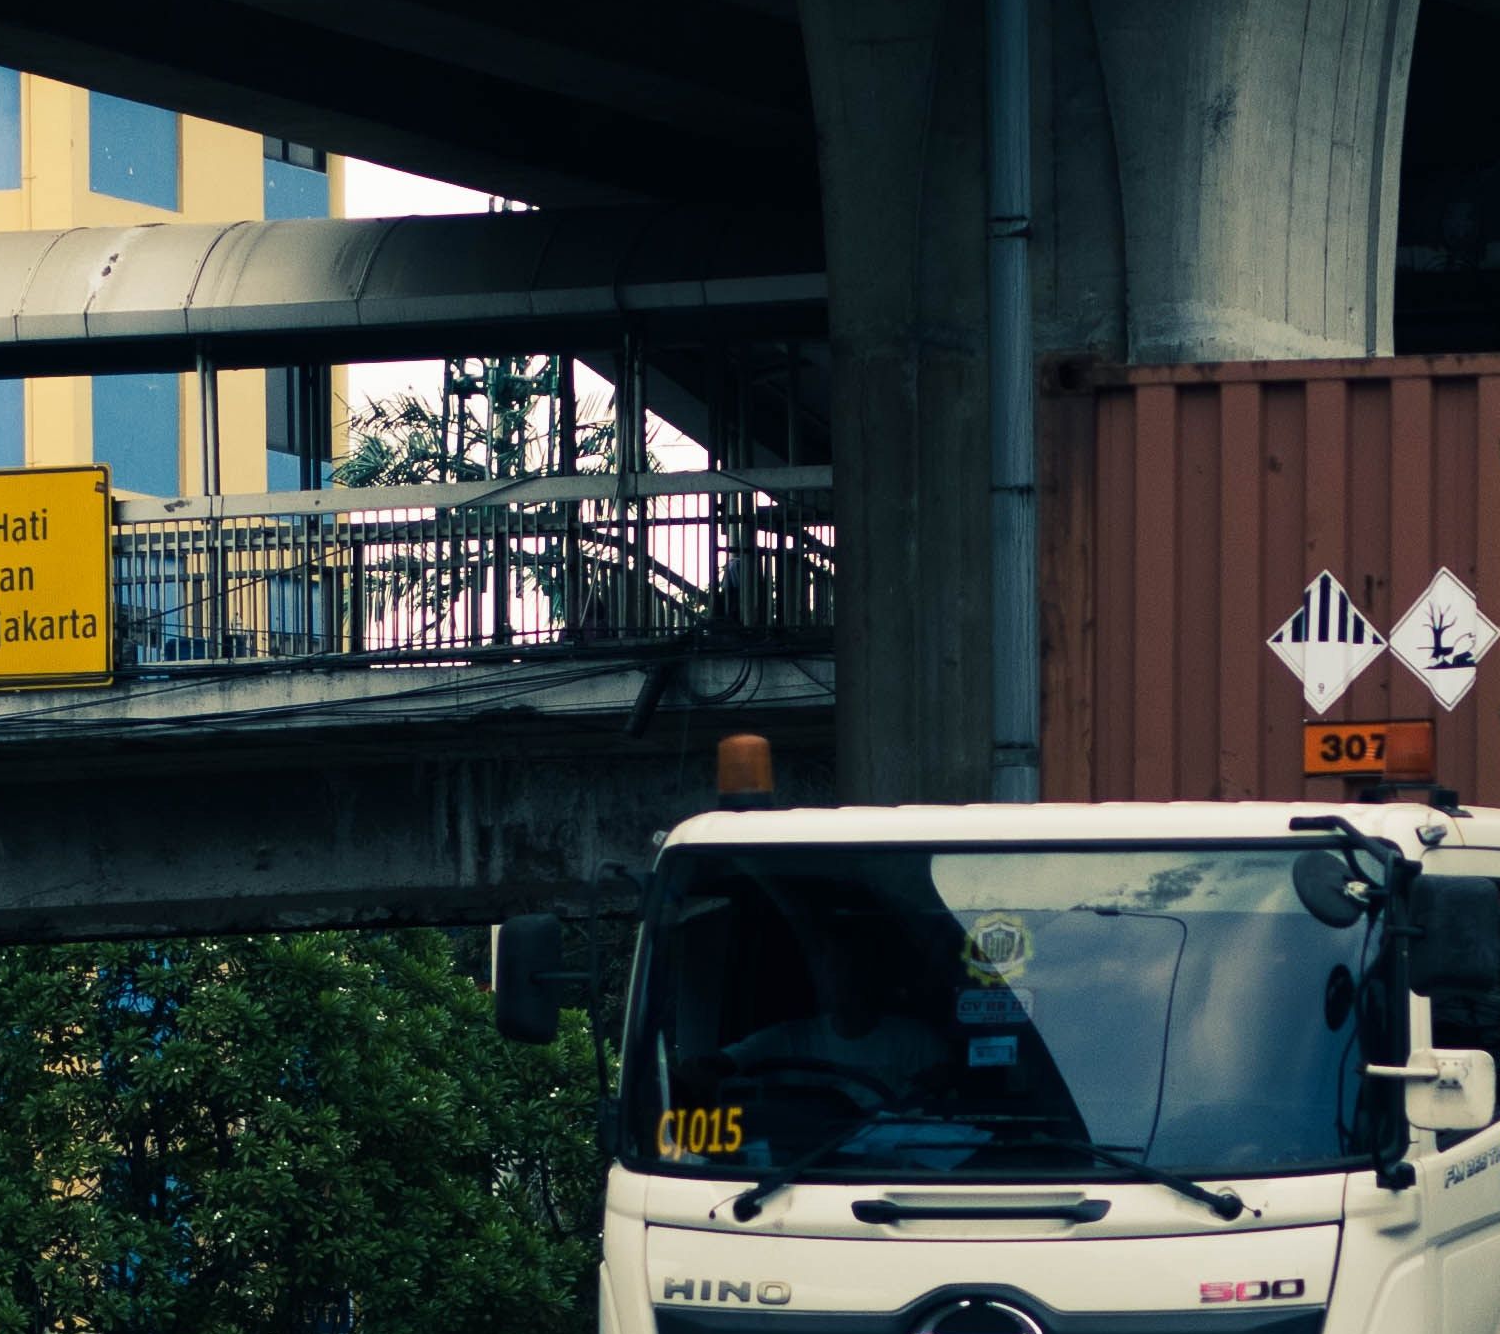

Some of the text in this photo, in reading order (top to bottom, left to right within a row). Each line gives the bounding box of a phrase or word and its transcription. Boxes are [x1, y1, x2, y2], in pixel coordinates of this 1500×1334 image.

[1320, 733, 1387, 762] 307
[663, 1277, 792, 1305] HINO
[1199, 1278, 1305, 1304] 500
